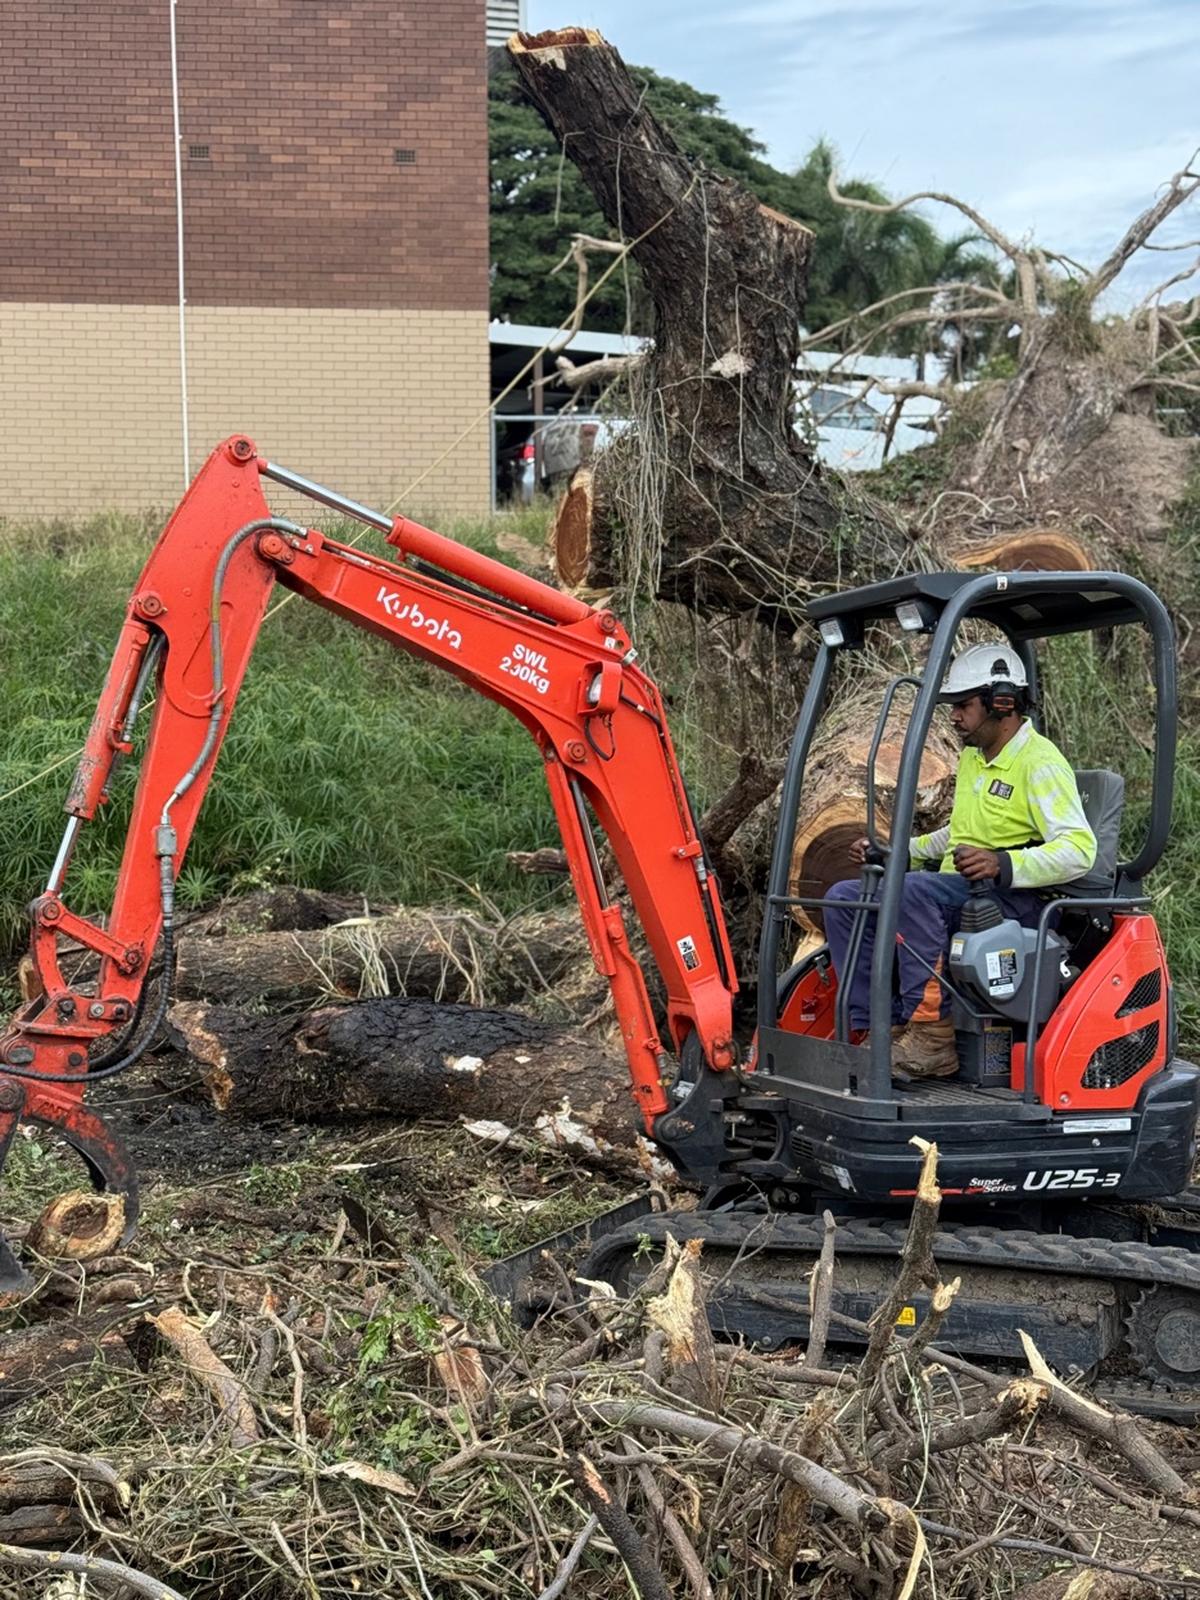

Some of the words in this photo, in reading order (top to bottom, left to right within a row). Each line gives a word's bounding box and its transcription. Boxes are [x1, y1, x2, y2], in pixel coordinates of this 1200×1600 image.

[376, 586, 462, 649] Kubota
[512, 643, 549, 673] SWL
[968, 1177, 1003, 1188] Super
[982, 1183, 1018, 1193] Series
[1022, 1168, 1122, 1191] U25-3
